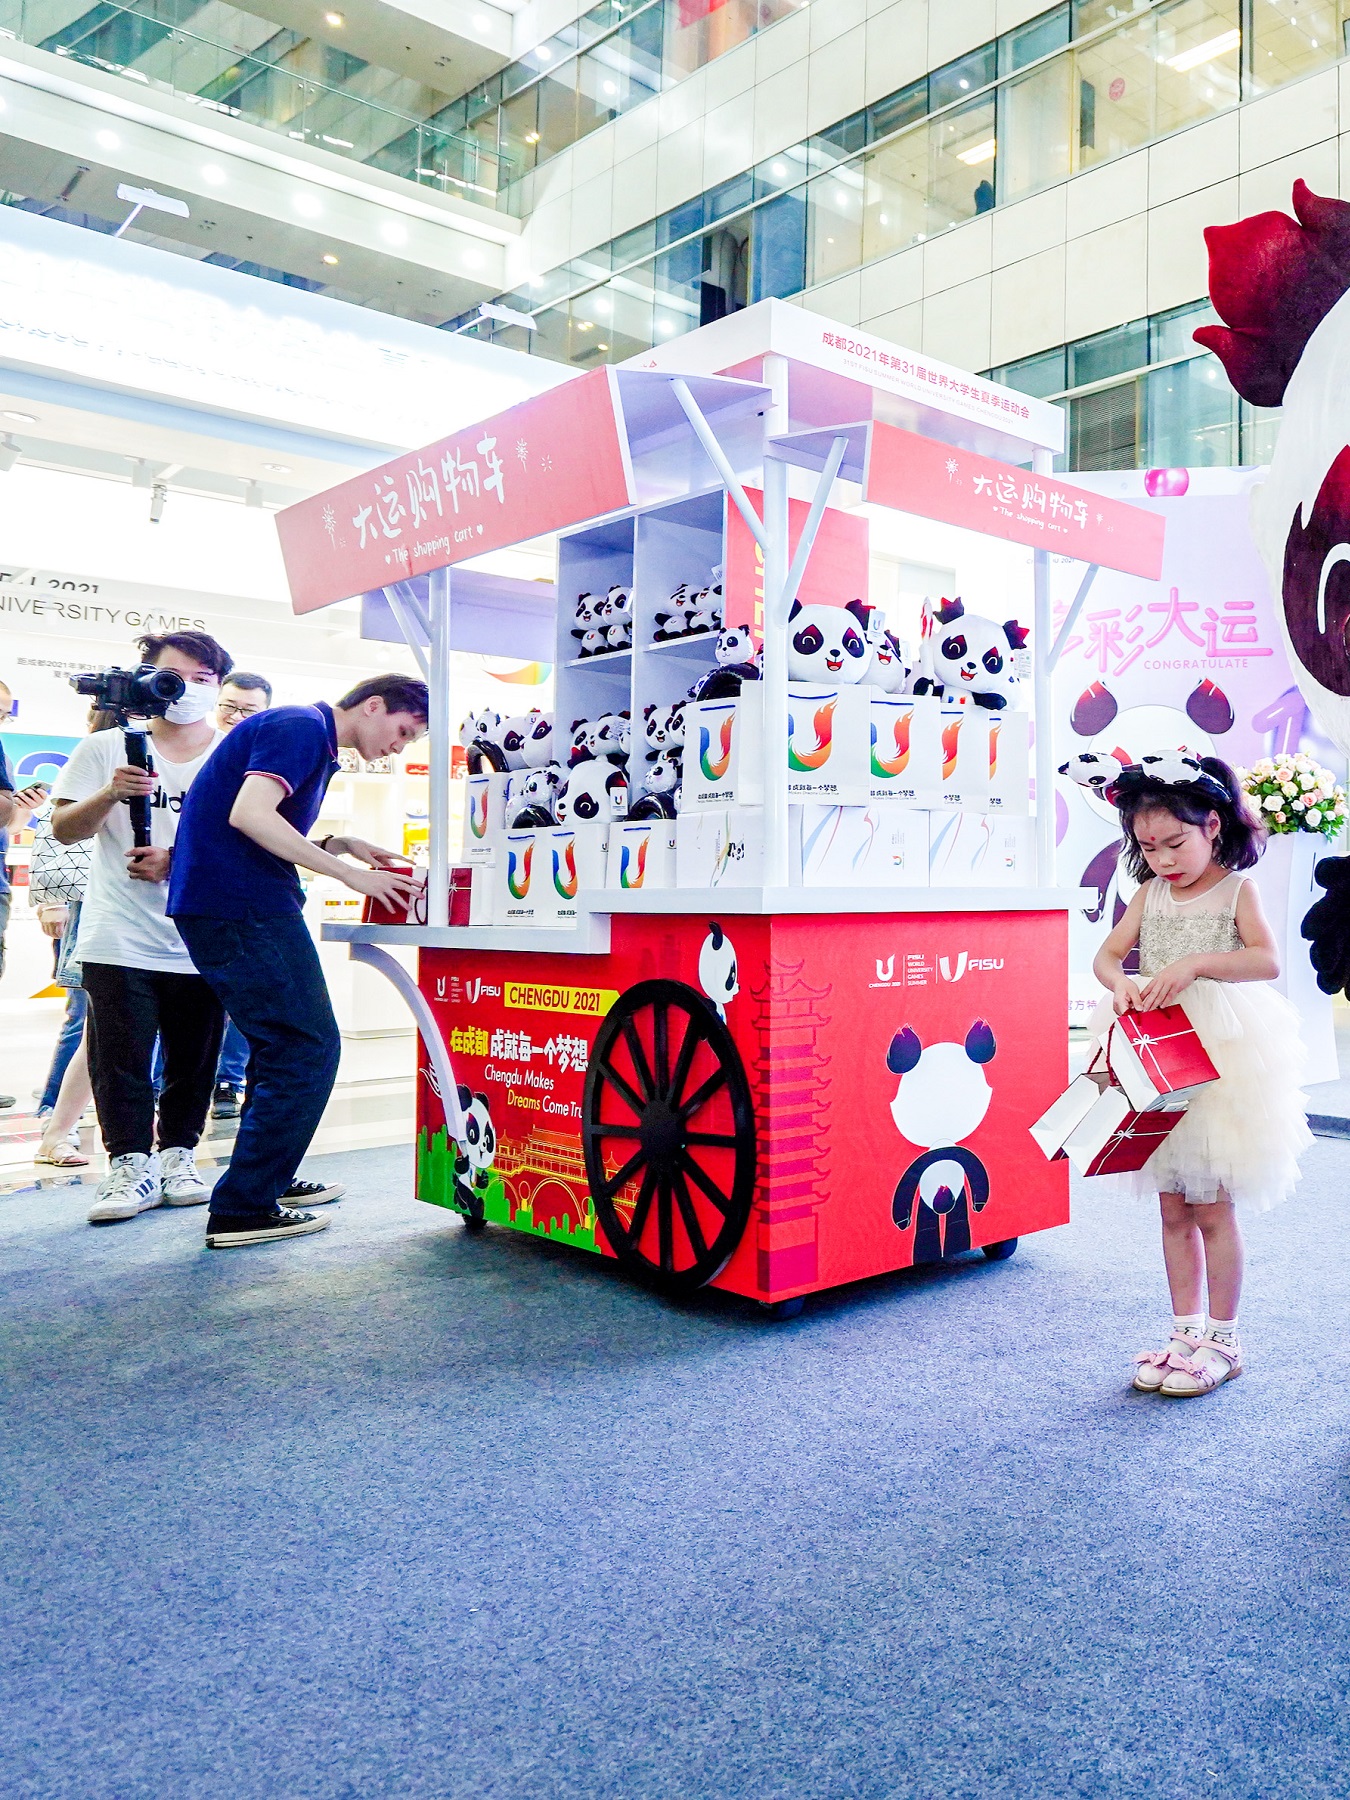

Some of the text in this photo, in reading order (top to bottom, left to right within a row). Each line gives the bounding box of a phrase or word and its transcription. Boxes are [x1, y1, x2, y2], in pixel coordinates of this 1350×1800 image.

[822, 332, 1030, 419] 成都2021年第31届世界大学生夏季运动会
[352, 431, 505, 550] 大运购物车
[972, 473, 1089, 529] 大运购物车
[1000, 506, 1062, 533] The shopping cart
[392, 526, 474, 563] The shopping cart
[1143, 658, 1249, 670] CONGRATULATE
[968, 958, 1005, 971] FISU
[480, 985, 501, 997] FISU
[509, 986, 601, 1012] CHENGDU 2021
[450, 1025, 589, 1074] 在成都 成就每一个梦想
[484, 1063, 555, 1091] Chengdu Makes
[507, 1089, 583, 1119] Dreams Come Tru
